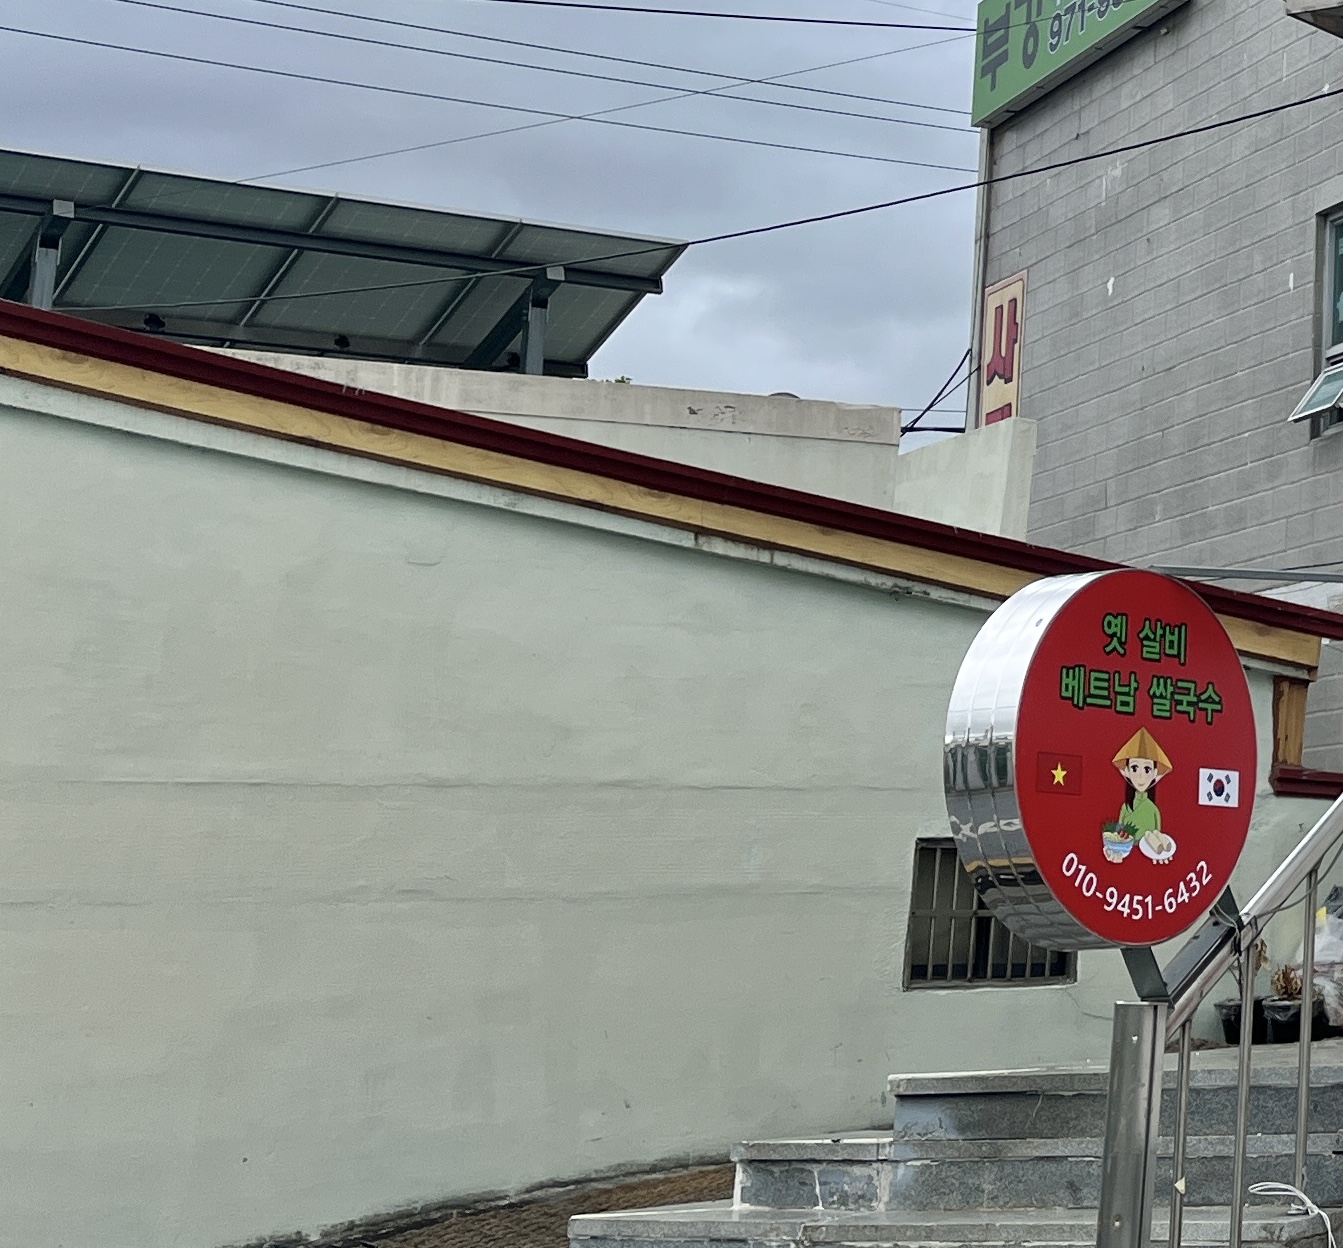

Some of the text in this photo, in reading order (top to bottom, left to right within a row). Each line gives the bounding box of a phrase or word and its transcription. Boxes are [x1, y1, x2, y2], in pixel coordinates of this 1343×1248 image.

[1102, 613, 1187, 665] 옛 살비
[1059, 664, 1223, 725] 베트남 쌀국수
[1061, 852, 1212, 920] 010-9451-6432
